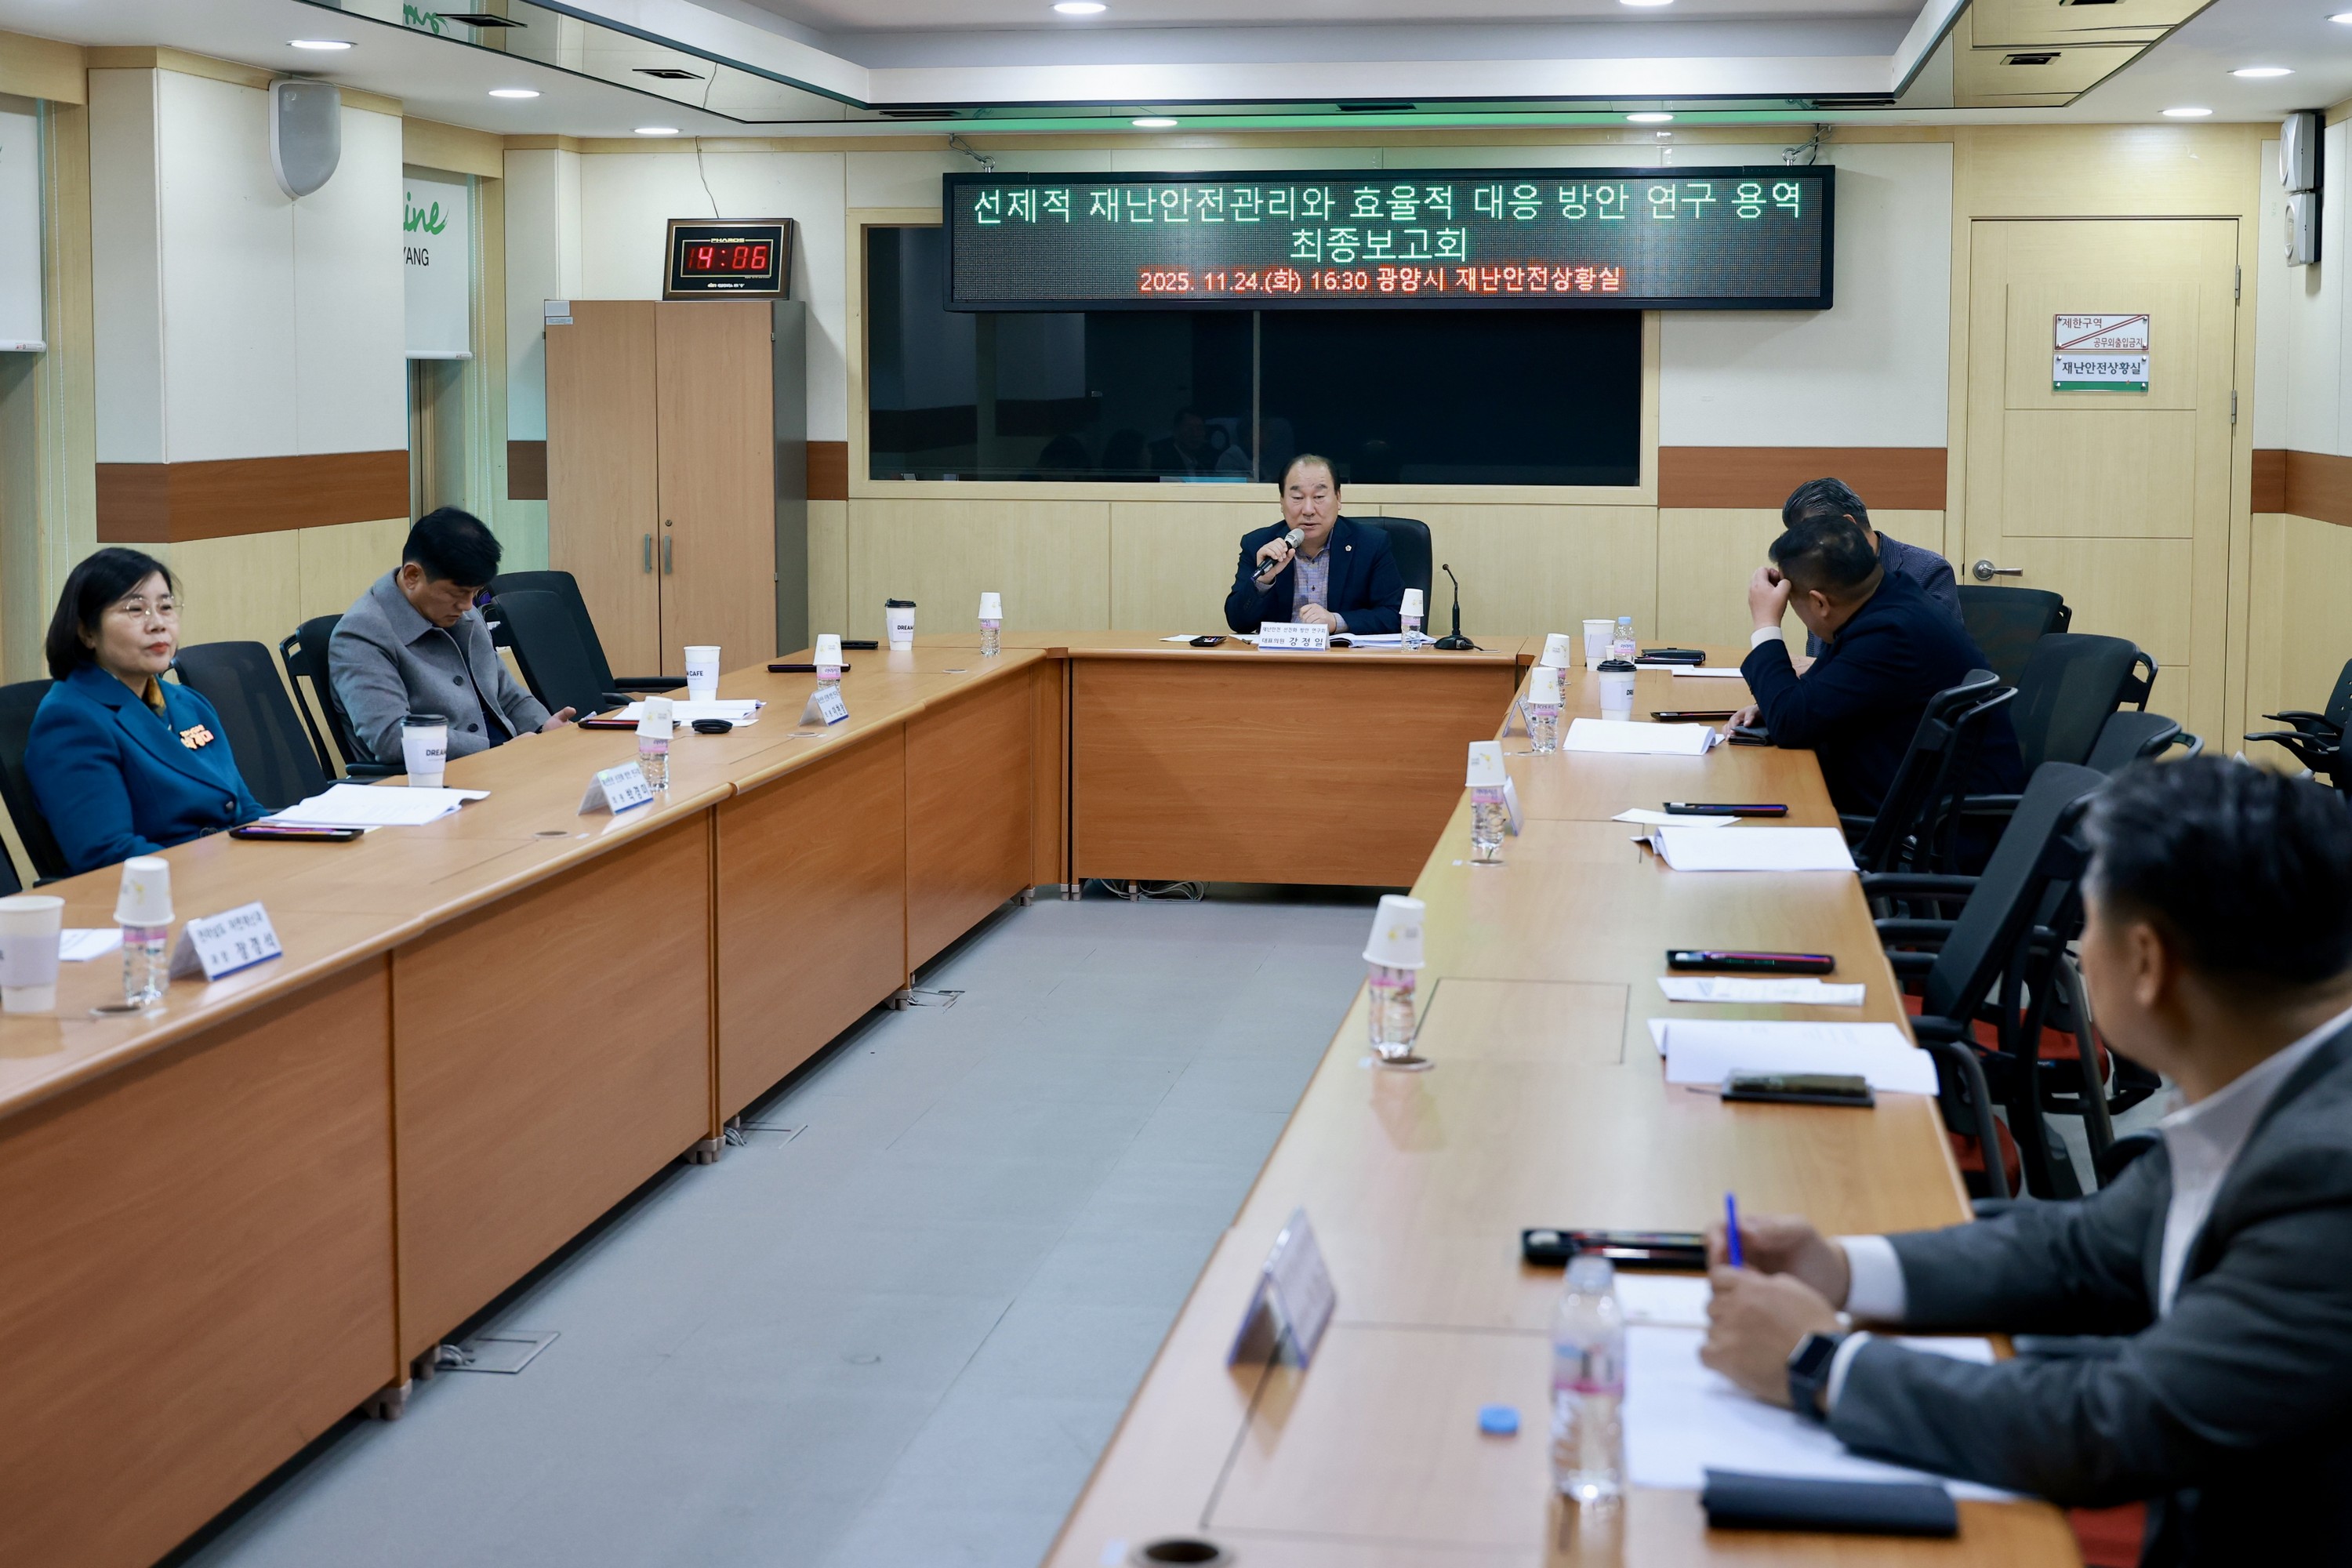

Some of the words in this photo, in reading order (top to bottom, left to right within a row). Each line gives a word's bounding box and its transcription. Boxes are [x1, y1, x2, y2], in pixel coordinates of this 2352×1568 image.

[404, 191, 449, 235] ine
[975, 189, 1069, 223] 선제적
[1090, 187, 1335, 223] 재난안전관리와
[1349, 186, 1451, 220] 효율적
[1475, 185, 1542, 220] 대응
[1559, 184, 1629, 220] 방안
[1648, 183, 1717, 219] 연구
[1731, 183, 1799, 219] 용역
[1290, 227, 1466, 263] 최종보고회
[698, 246, 768, 269] 4:06
[1141, 272, 1194, 291] 2025.
[1312, 271, 1367, 290] 16:30
[1377, 267, 1444, 292] 광양시
[1456, 266, 1621, 291] 재난안전상황실
[2062, 318, 2102, 328] 제한구역
[2093, 337, 2143, 348] 공무외출입금지
[2062, 361, 2141, 375] 재난안전상황실
